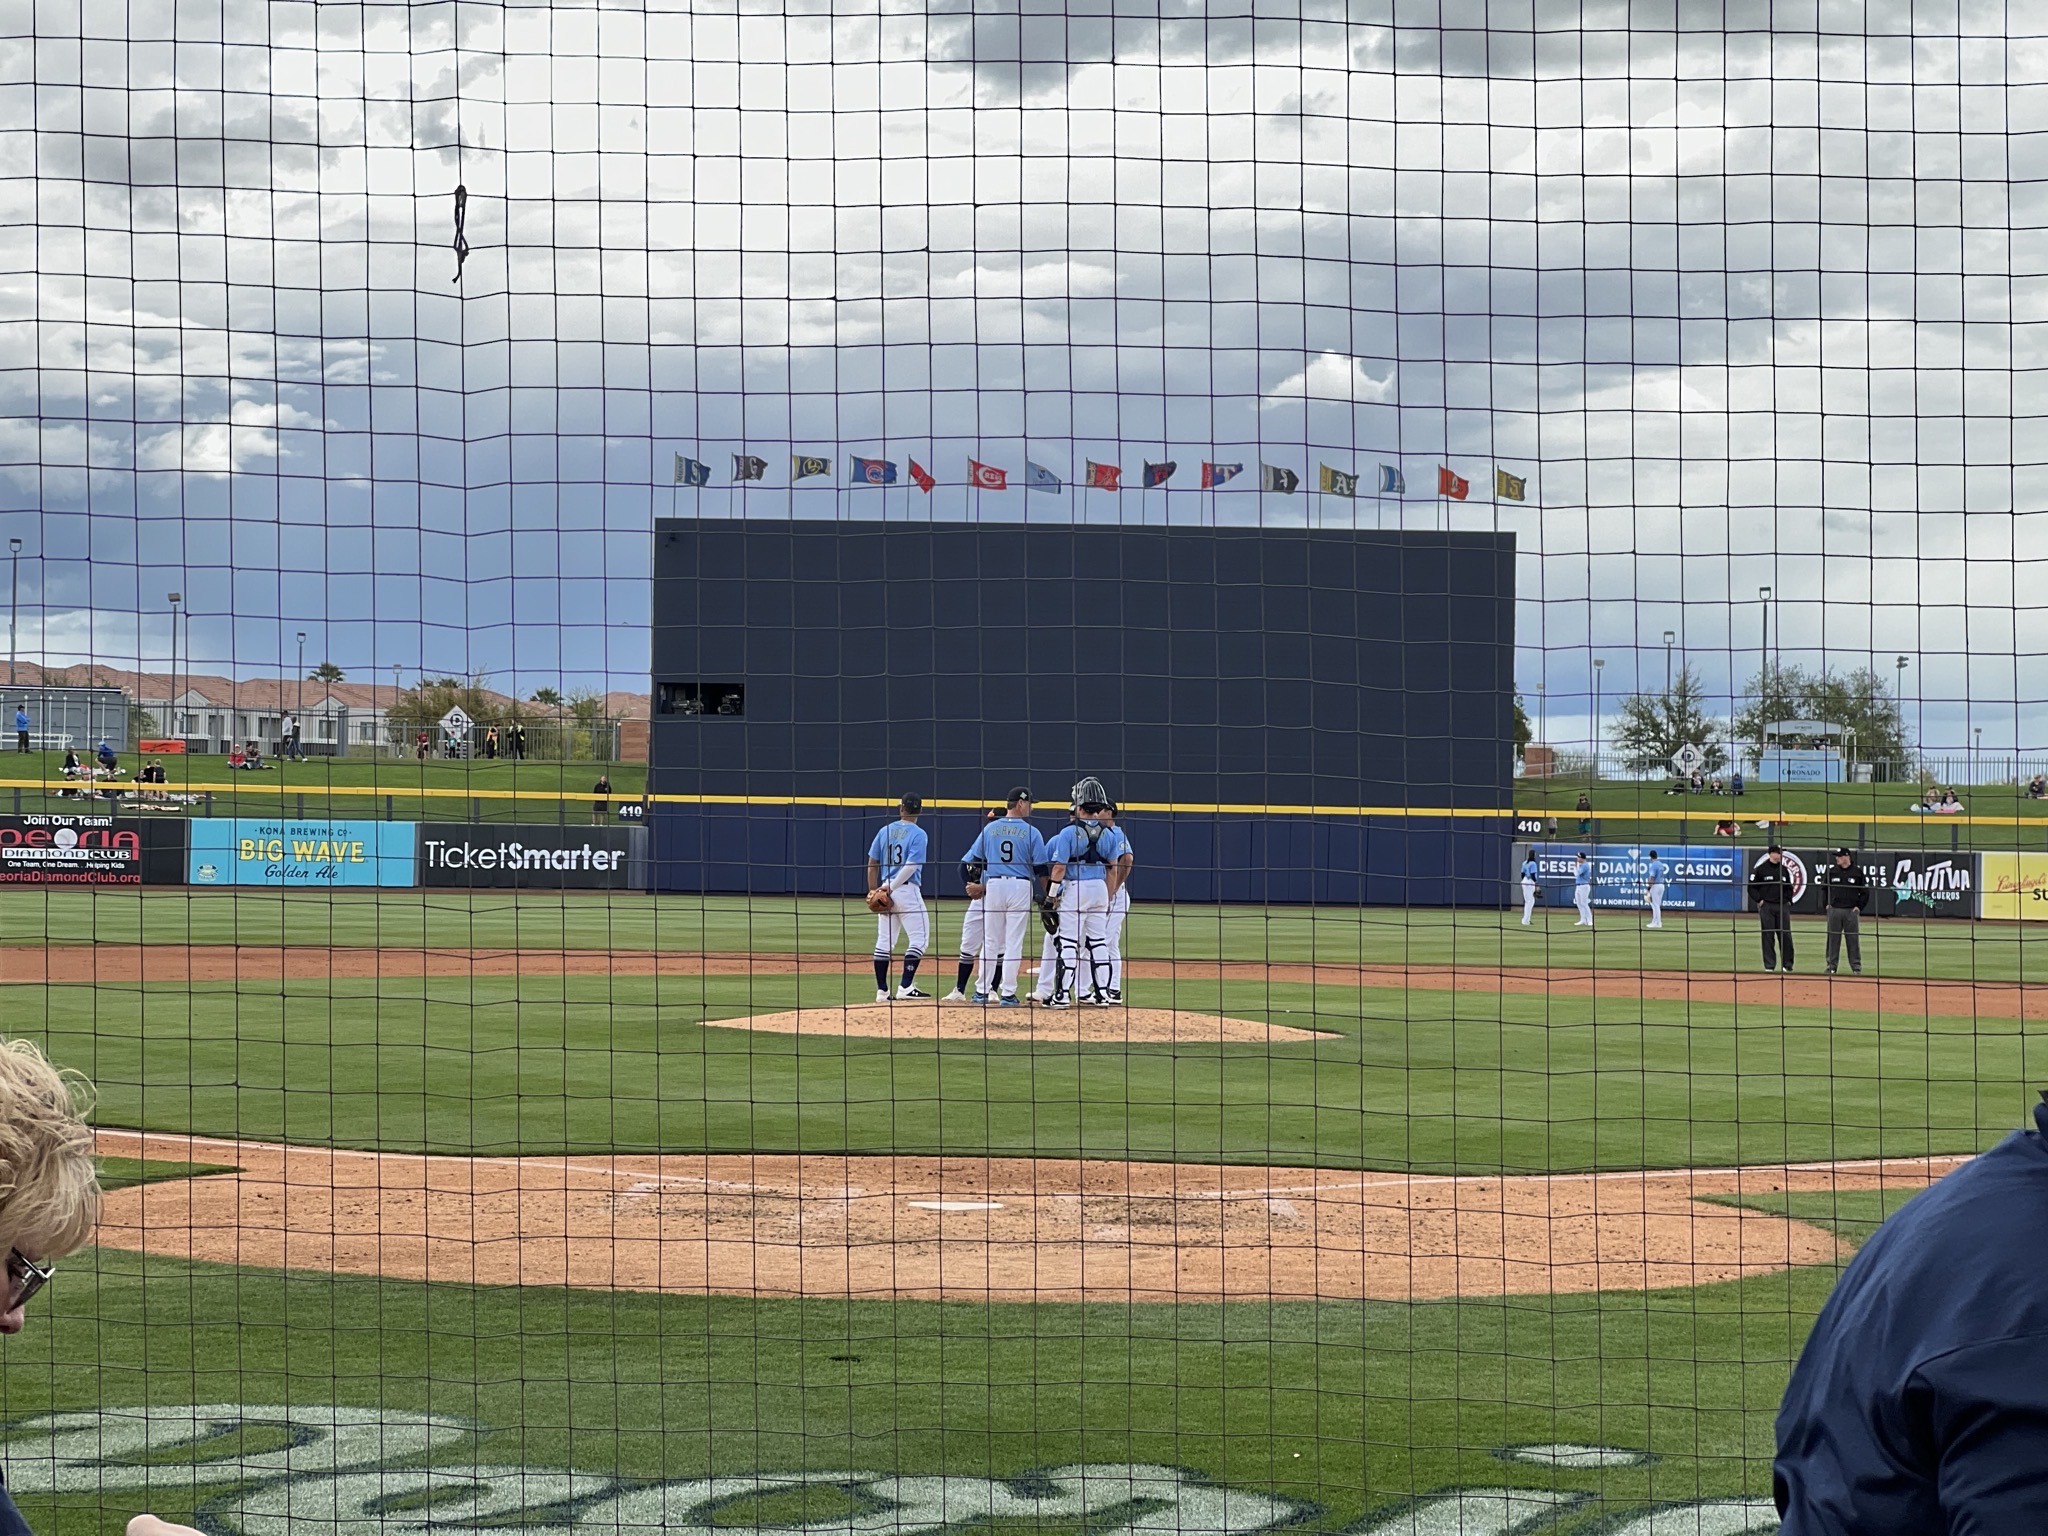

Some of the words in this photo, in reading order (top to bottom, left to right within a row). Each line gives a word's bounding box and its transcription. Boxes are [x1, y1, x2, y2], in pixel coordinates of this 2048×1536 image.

[619, 805, 643, 817] 410
[23, 815, 49, 826] Join
[52, 815, 76, 826] Our
[78, 816, 113, 827] Team!
[1517, 820, 1542, 833] 410
[259, 827, 285, 836] KONA
[290, 828, 334, 836] BREWING
[90, 850, 131, 859] CLUB
[239, 838, 284, 862] BIG
[292, 839, 366, 863] WAVE
[425, 840, 625, 871] TicketSmarter
[889, 843, 903, 865] 13
[1000, 840, 1013, 863] 9
[265, 864, 309, 878] Golden
[315, 865, 339, 879] Ale
[1539, 860, 1595, 873] DESET
[1600, 862, 1669, 875] DIAMOD
[1675, 863, 1732, 877] CASINO
[1597, 876, 1627, 887] WEST
